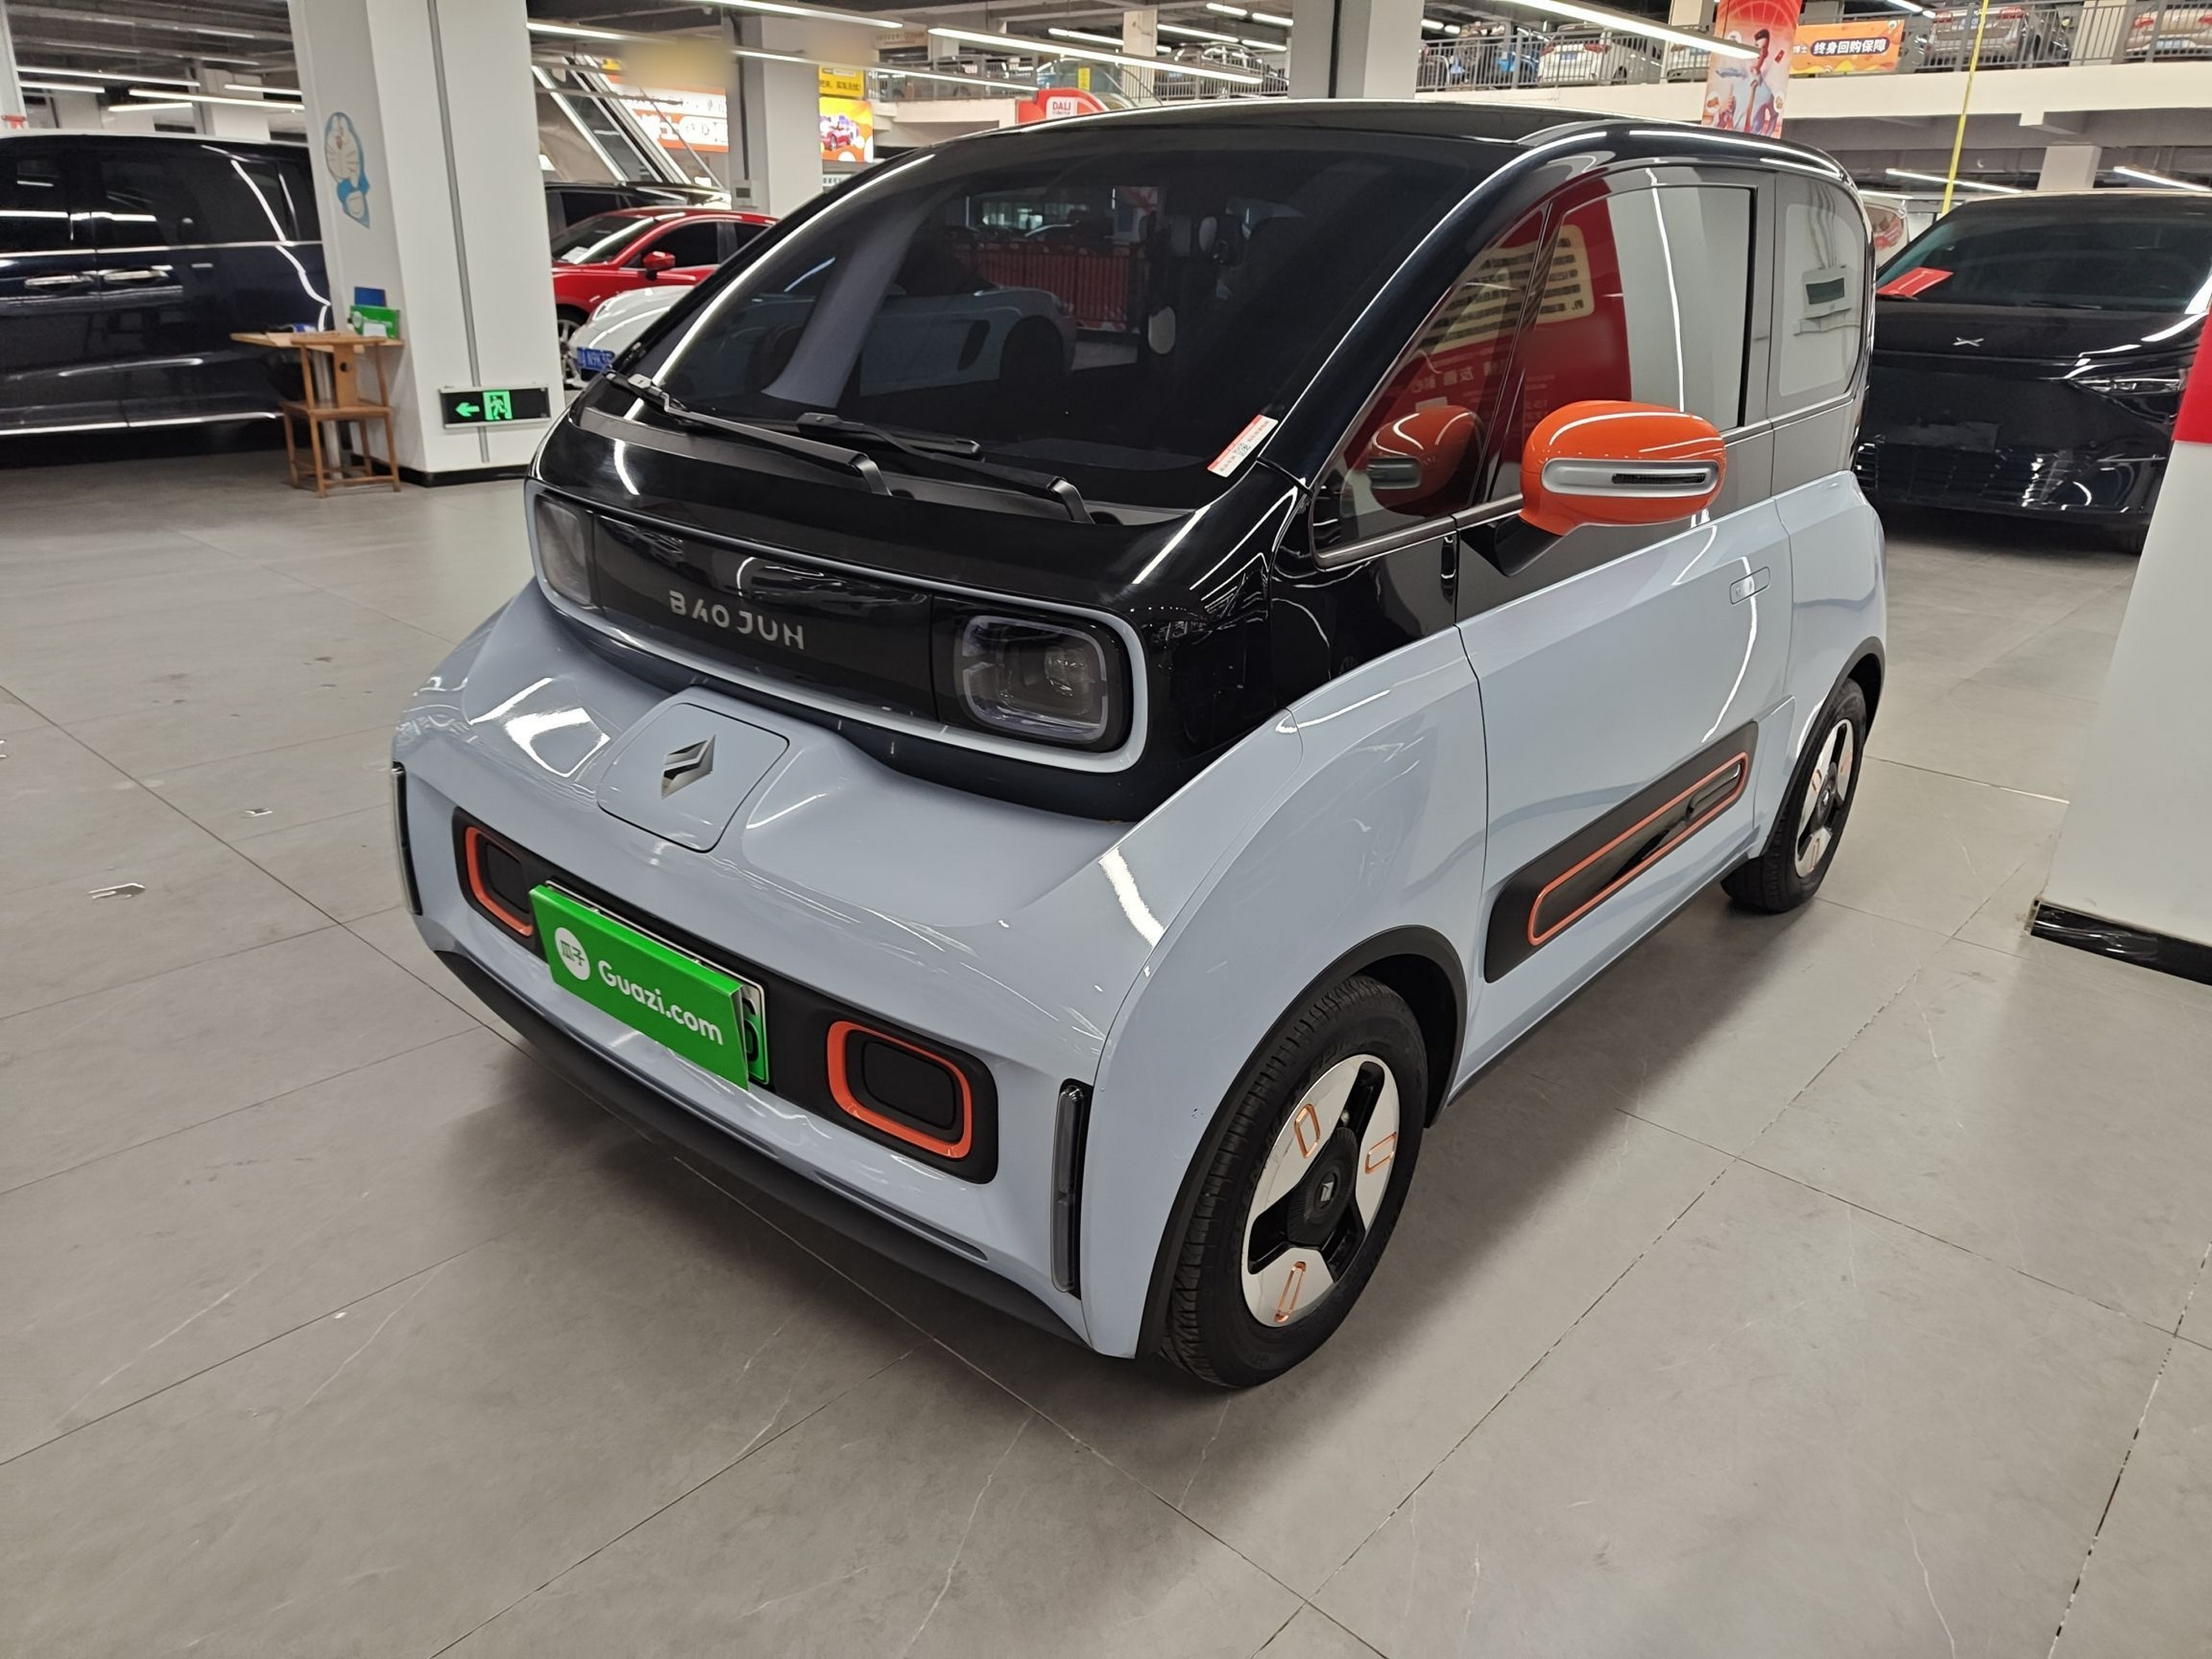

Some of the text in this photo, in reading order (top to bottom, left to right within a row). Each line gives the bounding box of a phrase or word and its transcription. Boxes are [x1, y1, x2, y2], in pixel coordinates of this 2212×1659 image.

[1813, 39, 1887, 54] 终身回购保障
[669, 590, 804, 650] BAOJUN
[560, 940, 585, 967] 瓜子
[598, 960, 724, 1045] Guazi.com
